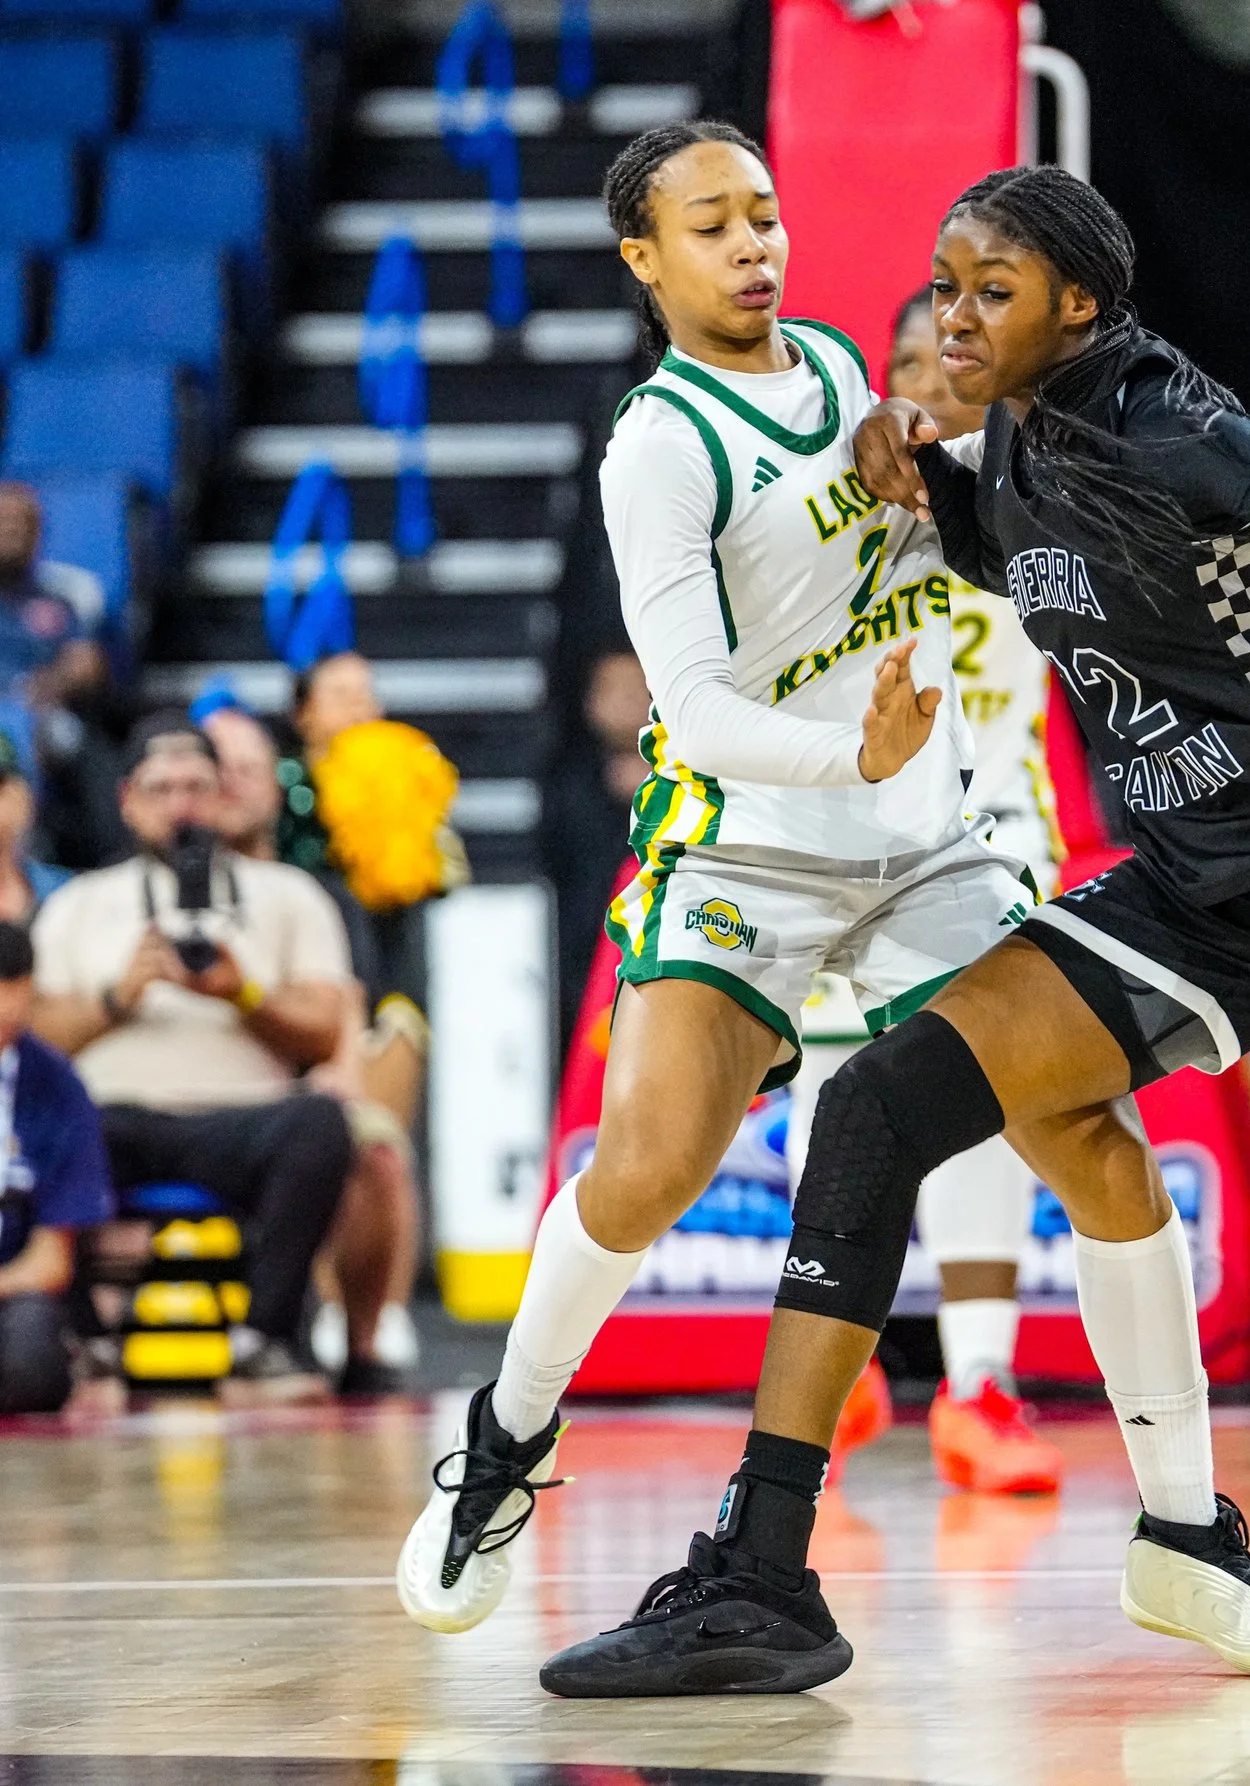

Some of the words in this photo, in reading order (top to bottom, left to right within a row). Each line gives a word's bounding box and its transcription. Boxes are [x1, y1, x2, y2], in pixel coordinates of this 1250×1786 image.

[804, 466, 886, 545] LAD
[848, 523, 891, 621] 2
[1006, 547, 1107, 627] SIERRA
